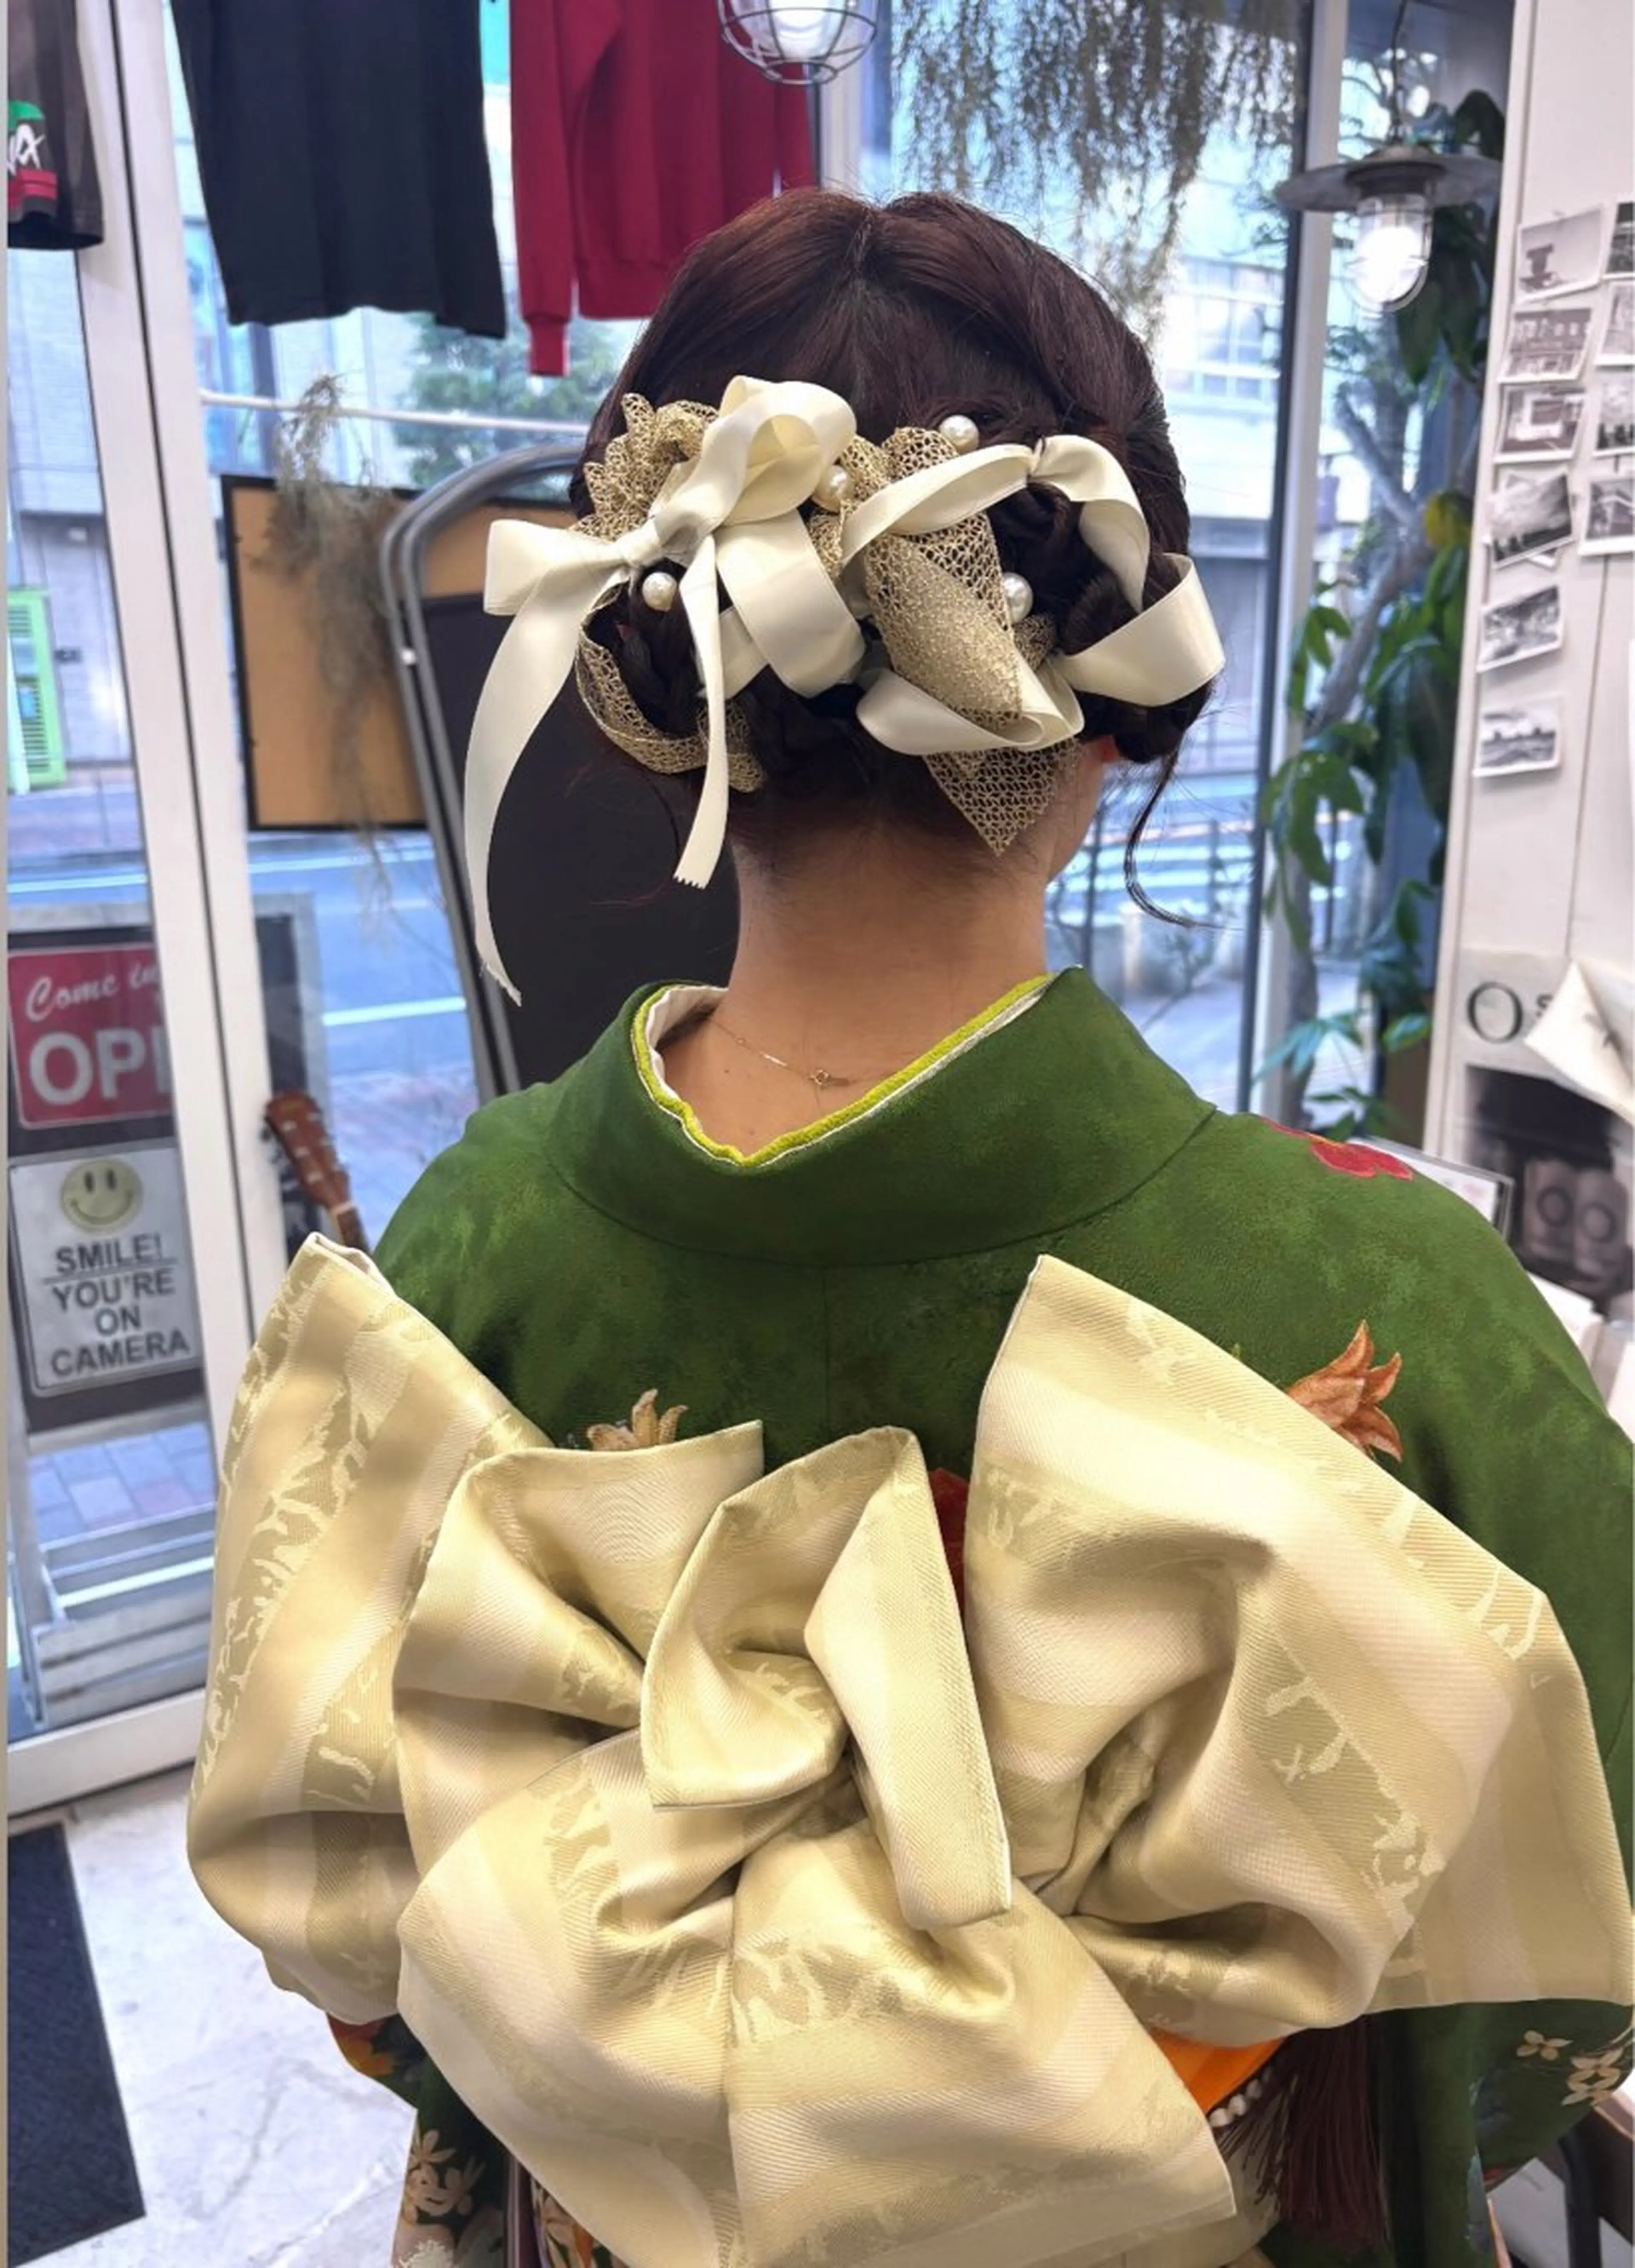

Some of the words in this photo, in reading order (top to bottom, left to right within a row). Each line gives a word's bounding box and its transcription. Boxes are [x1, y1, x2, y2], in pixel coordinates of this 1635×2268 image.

[26, 974, 118, 1022] Come
[55, 1232, 163, 1275] SMILE!
[52, 1267, 177, 1313] YOU'RE
[94, 1304, 143, 1336] ON
[50, 1327, 191, 1377] CAMERA
